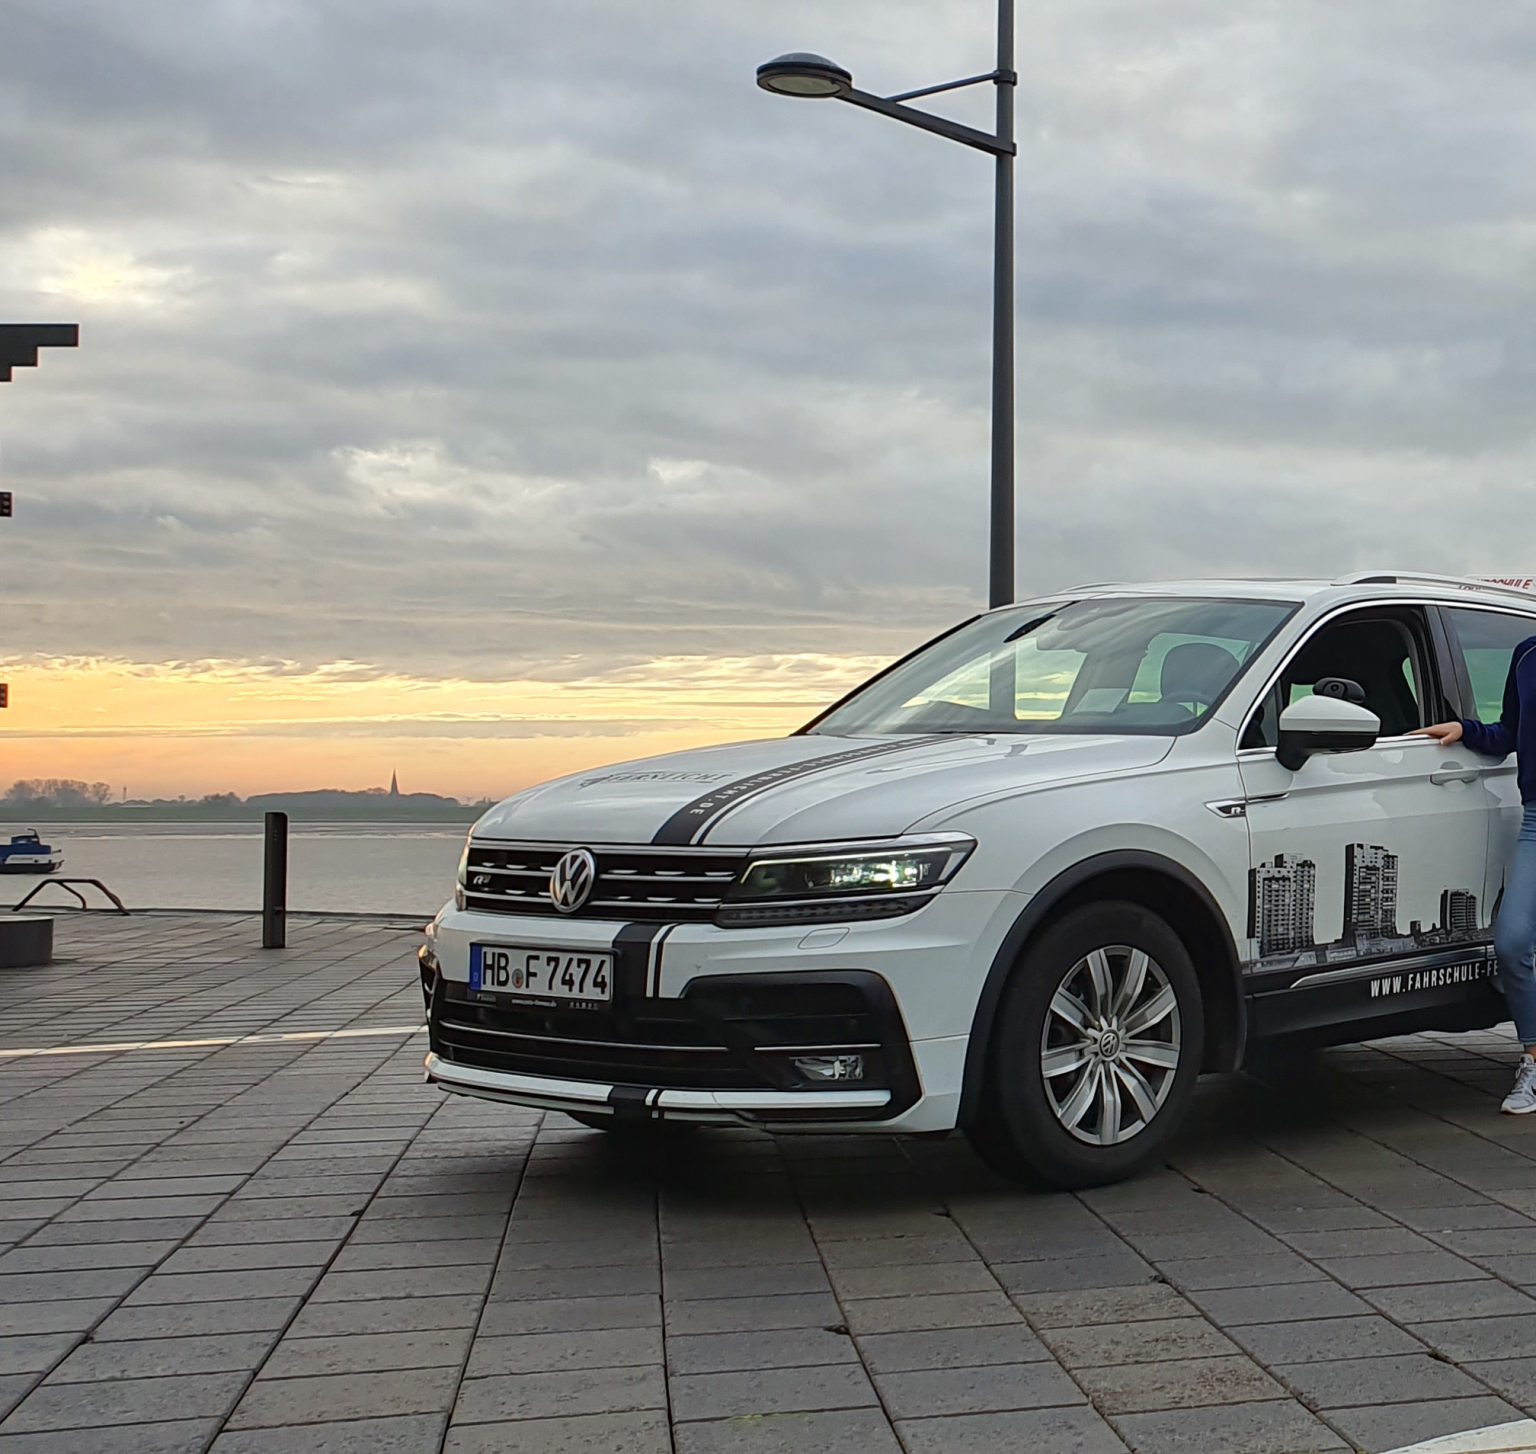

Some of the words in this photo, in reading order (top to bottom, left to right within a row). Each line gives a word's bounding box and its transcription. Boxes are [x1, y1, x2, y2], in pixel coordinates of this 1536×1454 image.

[483, 950, 509, 987] HB
[525, 954, 540, 989] F
[546, 955, 608, 995] 7474
